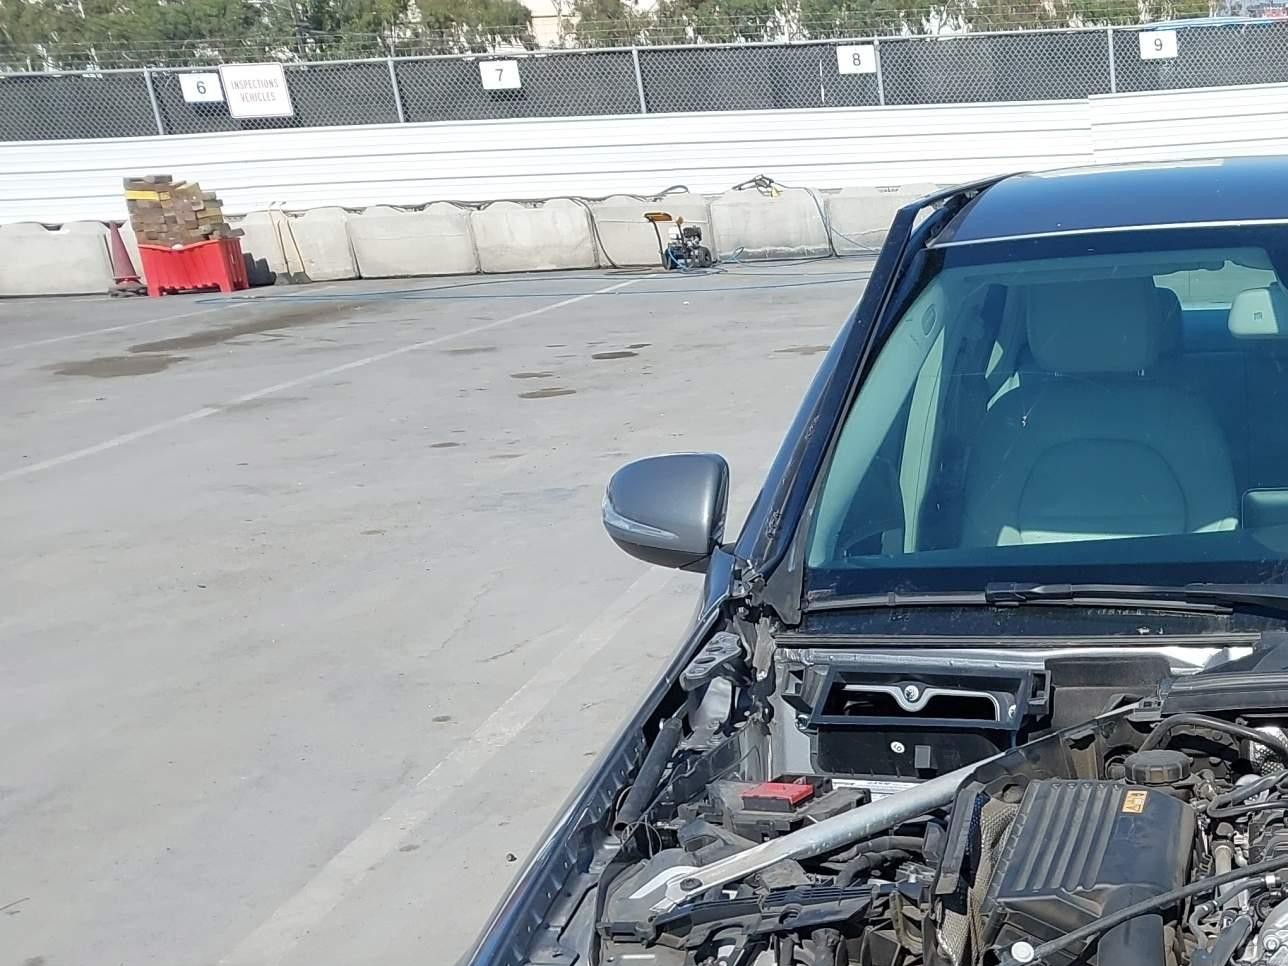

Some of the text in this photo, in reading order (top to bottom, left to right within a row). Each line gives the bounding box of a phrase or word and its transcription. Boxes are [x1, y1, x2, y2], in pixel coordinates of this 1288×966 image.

[1154, 38, 1163, 52] 9
[852, 52, 861, 66] 8
[495, 68, 504, 81] 7
[196, 80, 207, 95] 6
[230, 78, 280, 90] INSPECTIONS
[240, 91, 277, 103] VEHICLES
